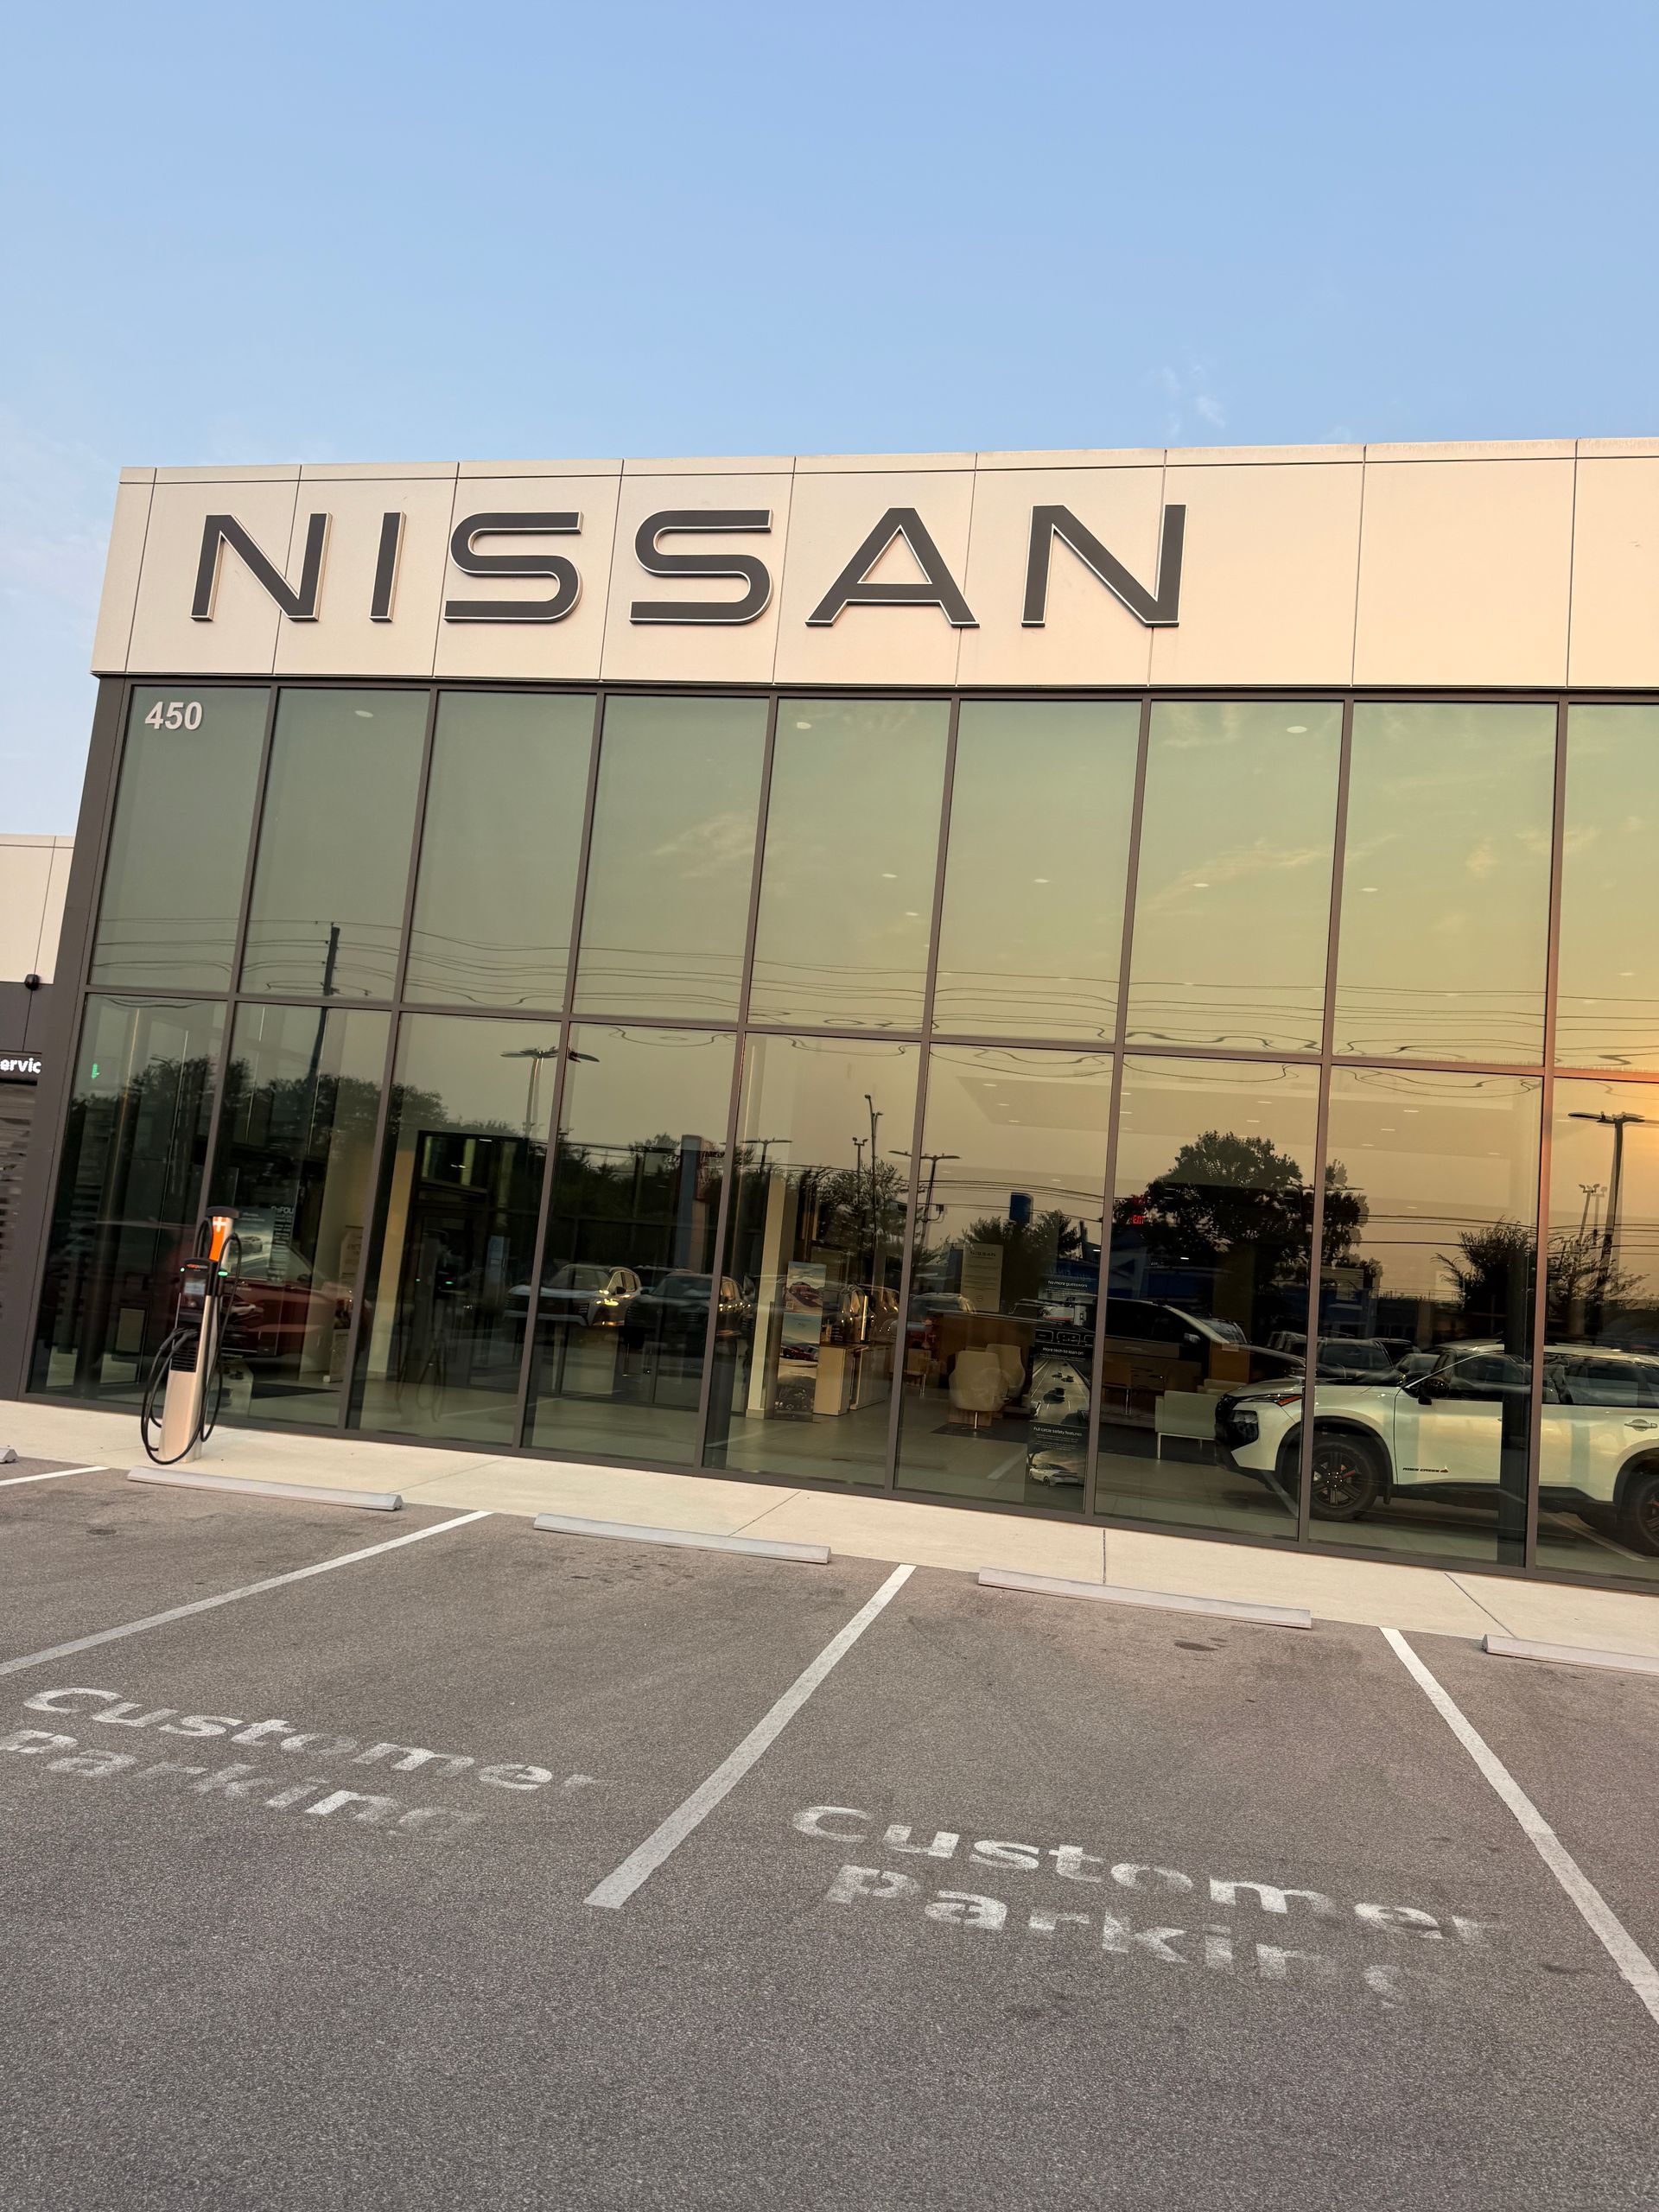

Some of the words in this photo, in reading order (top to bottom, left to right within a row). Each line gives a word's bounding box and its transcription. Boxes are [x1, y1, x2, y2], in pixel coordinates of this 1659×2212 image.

[190, 504, 1187, 629] NISSAN
[144, 701, 203, 730] 450
[0, 1058, 41, 1074] ervic
[23, 1687, 605, 1791] Customer
[792, 1805, 1499, 1944] Customer
